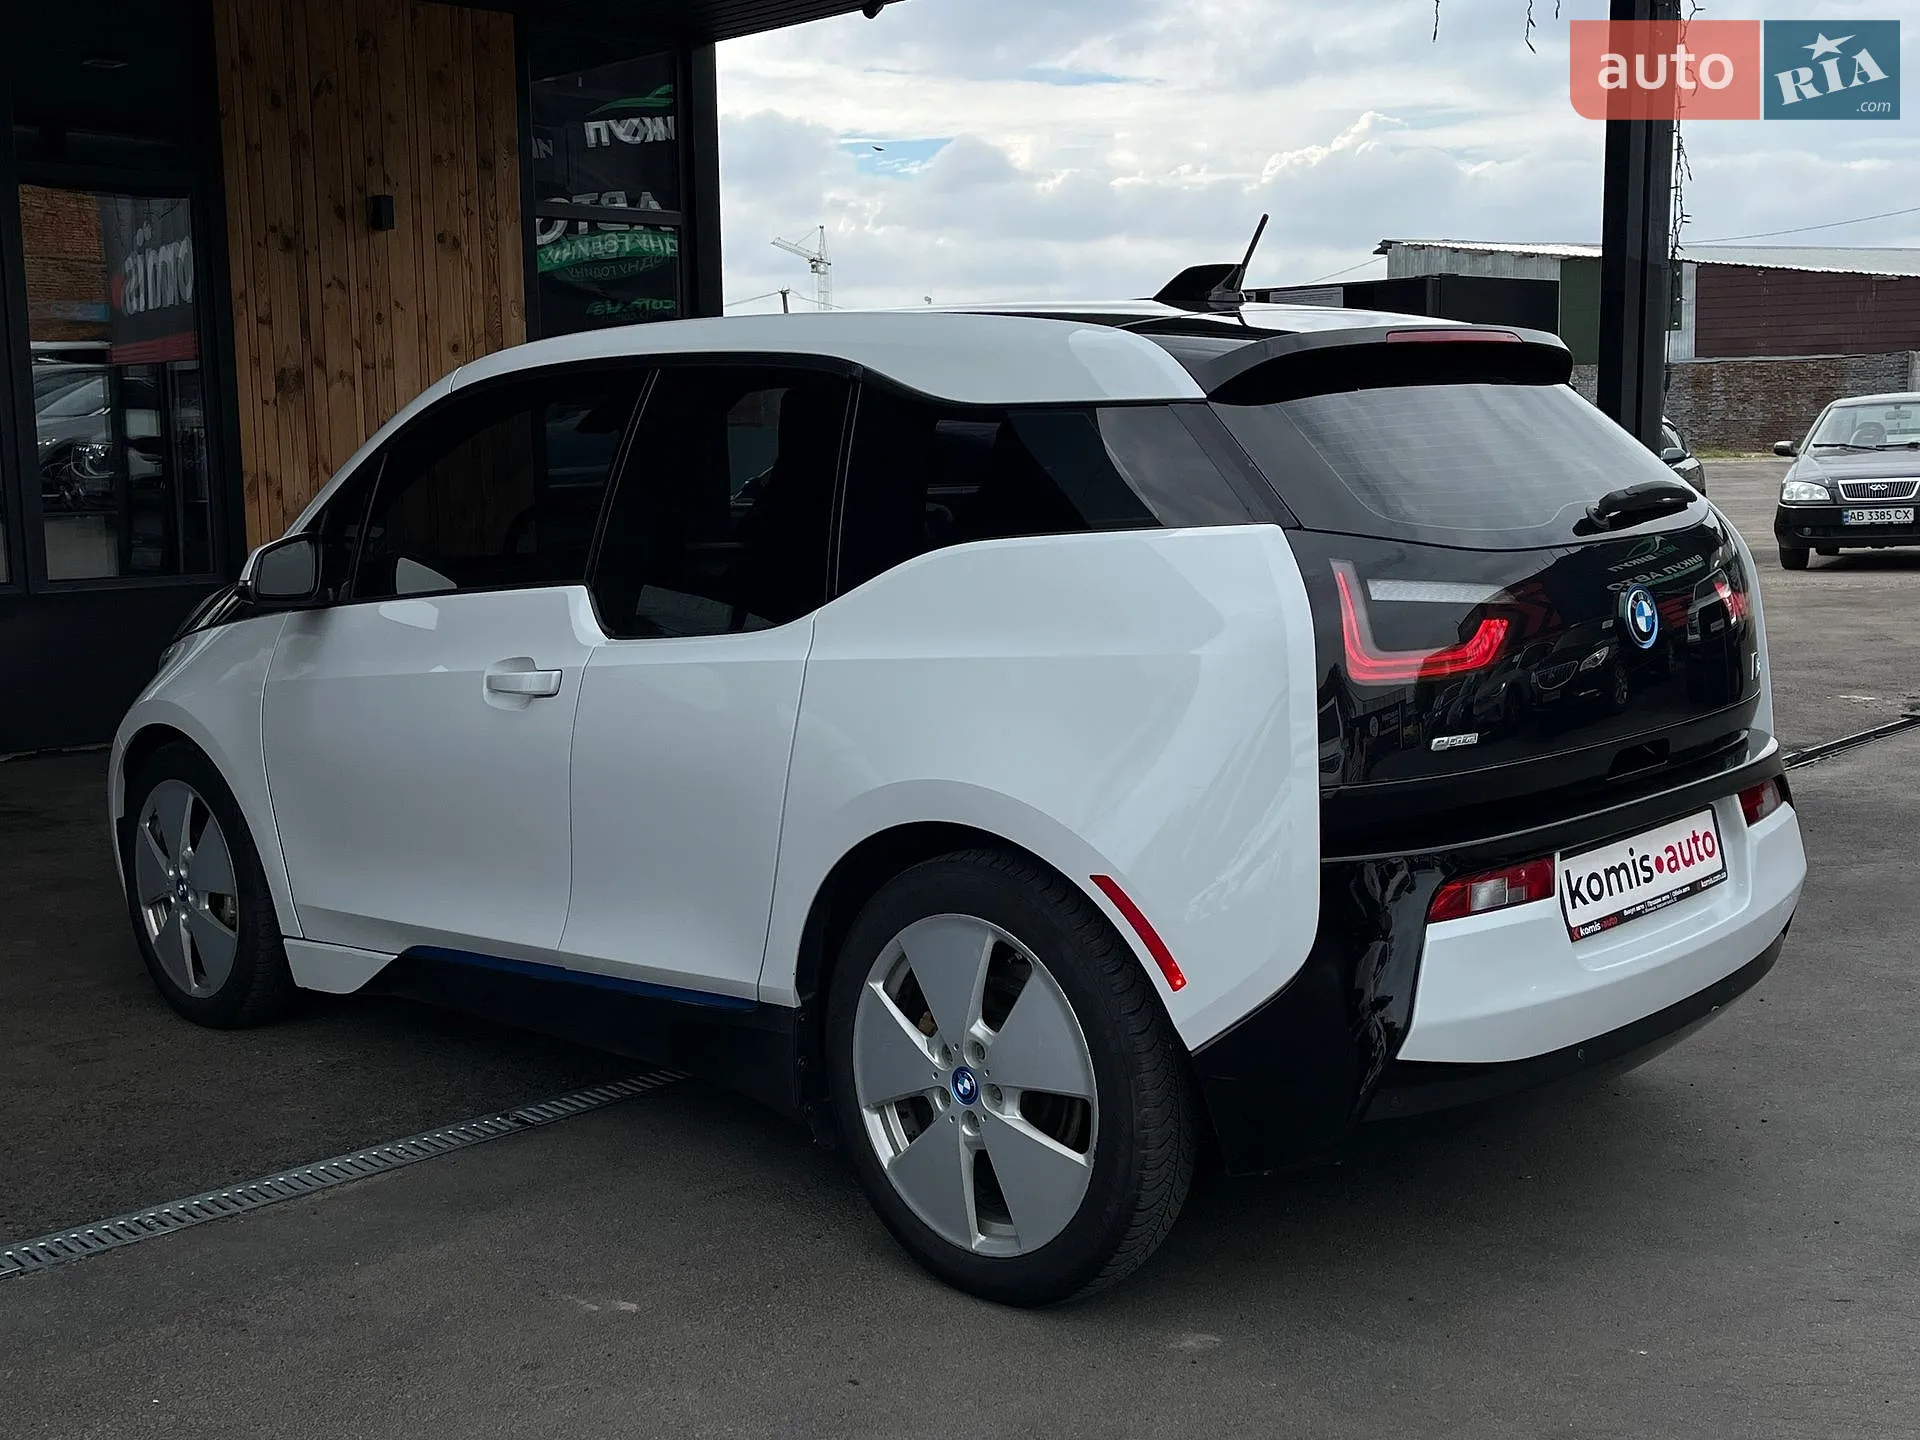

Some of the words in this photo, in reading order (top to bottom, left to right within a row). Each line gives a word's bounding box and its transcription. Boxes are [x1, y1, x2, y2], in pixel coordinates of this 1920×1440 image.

[1849, 511, 1864, 521] AB
[1867, 510, 1892, 521] 3385
[1895, 509, 1910, 520] CX
